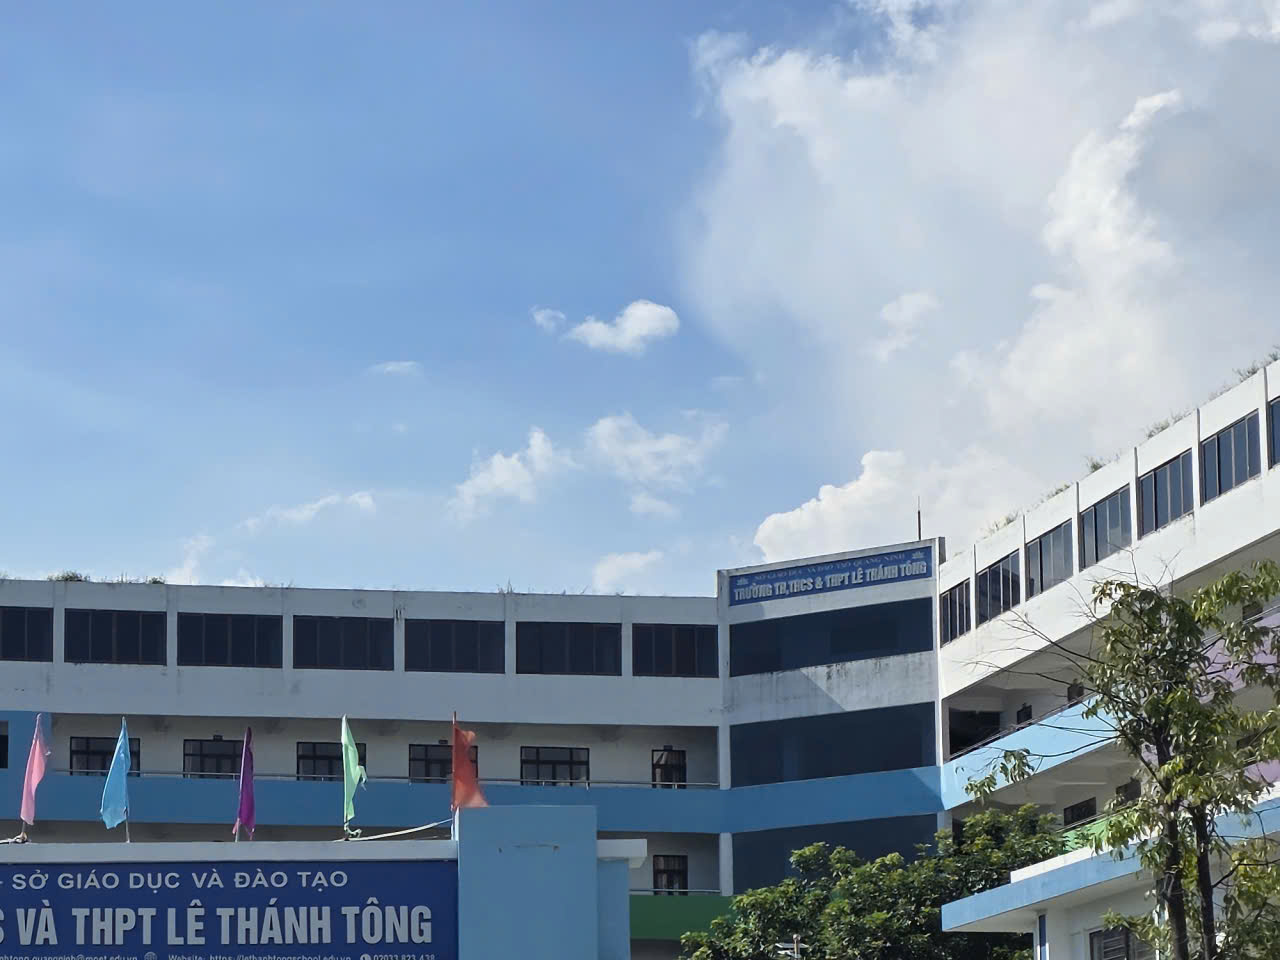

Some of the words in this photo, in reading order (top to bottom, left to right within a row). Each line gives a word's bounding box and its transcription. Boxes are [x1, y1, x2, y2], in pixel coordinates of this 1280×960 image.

[734, 582, 773, 601] TRƯỜNG
[815, 577, 824, 589] &
[824, 572, 851, 587] THPT
[851, 567, 864, 584] LÊ
[864, 564, 899, 582] THÁNH
[899, 560, 927, 577] TÔNG
[12, 869, 49, 890] SỞ
[57, 869, 120, 889] GIÁO
[129, 872, 180, 894] DỤC
[191, 869, 224, 888] VÀ
[233, 868, 288, 888] ĐÀO
[297, 870, 349, 892] TẠO
[16, 899, 58, 945] VÀ
[71, 907, 157, 945] THPT
[167, 899, 206, 945] LÊ
[215, 897, 332, 945] THÁNH
[341, 896, 432, 944] TÔNG
